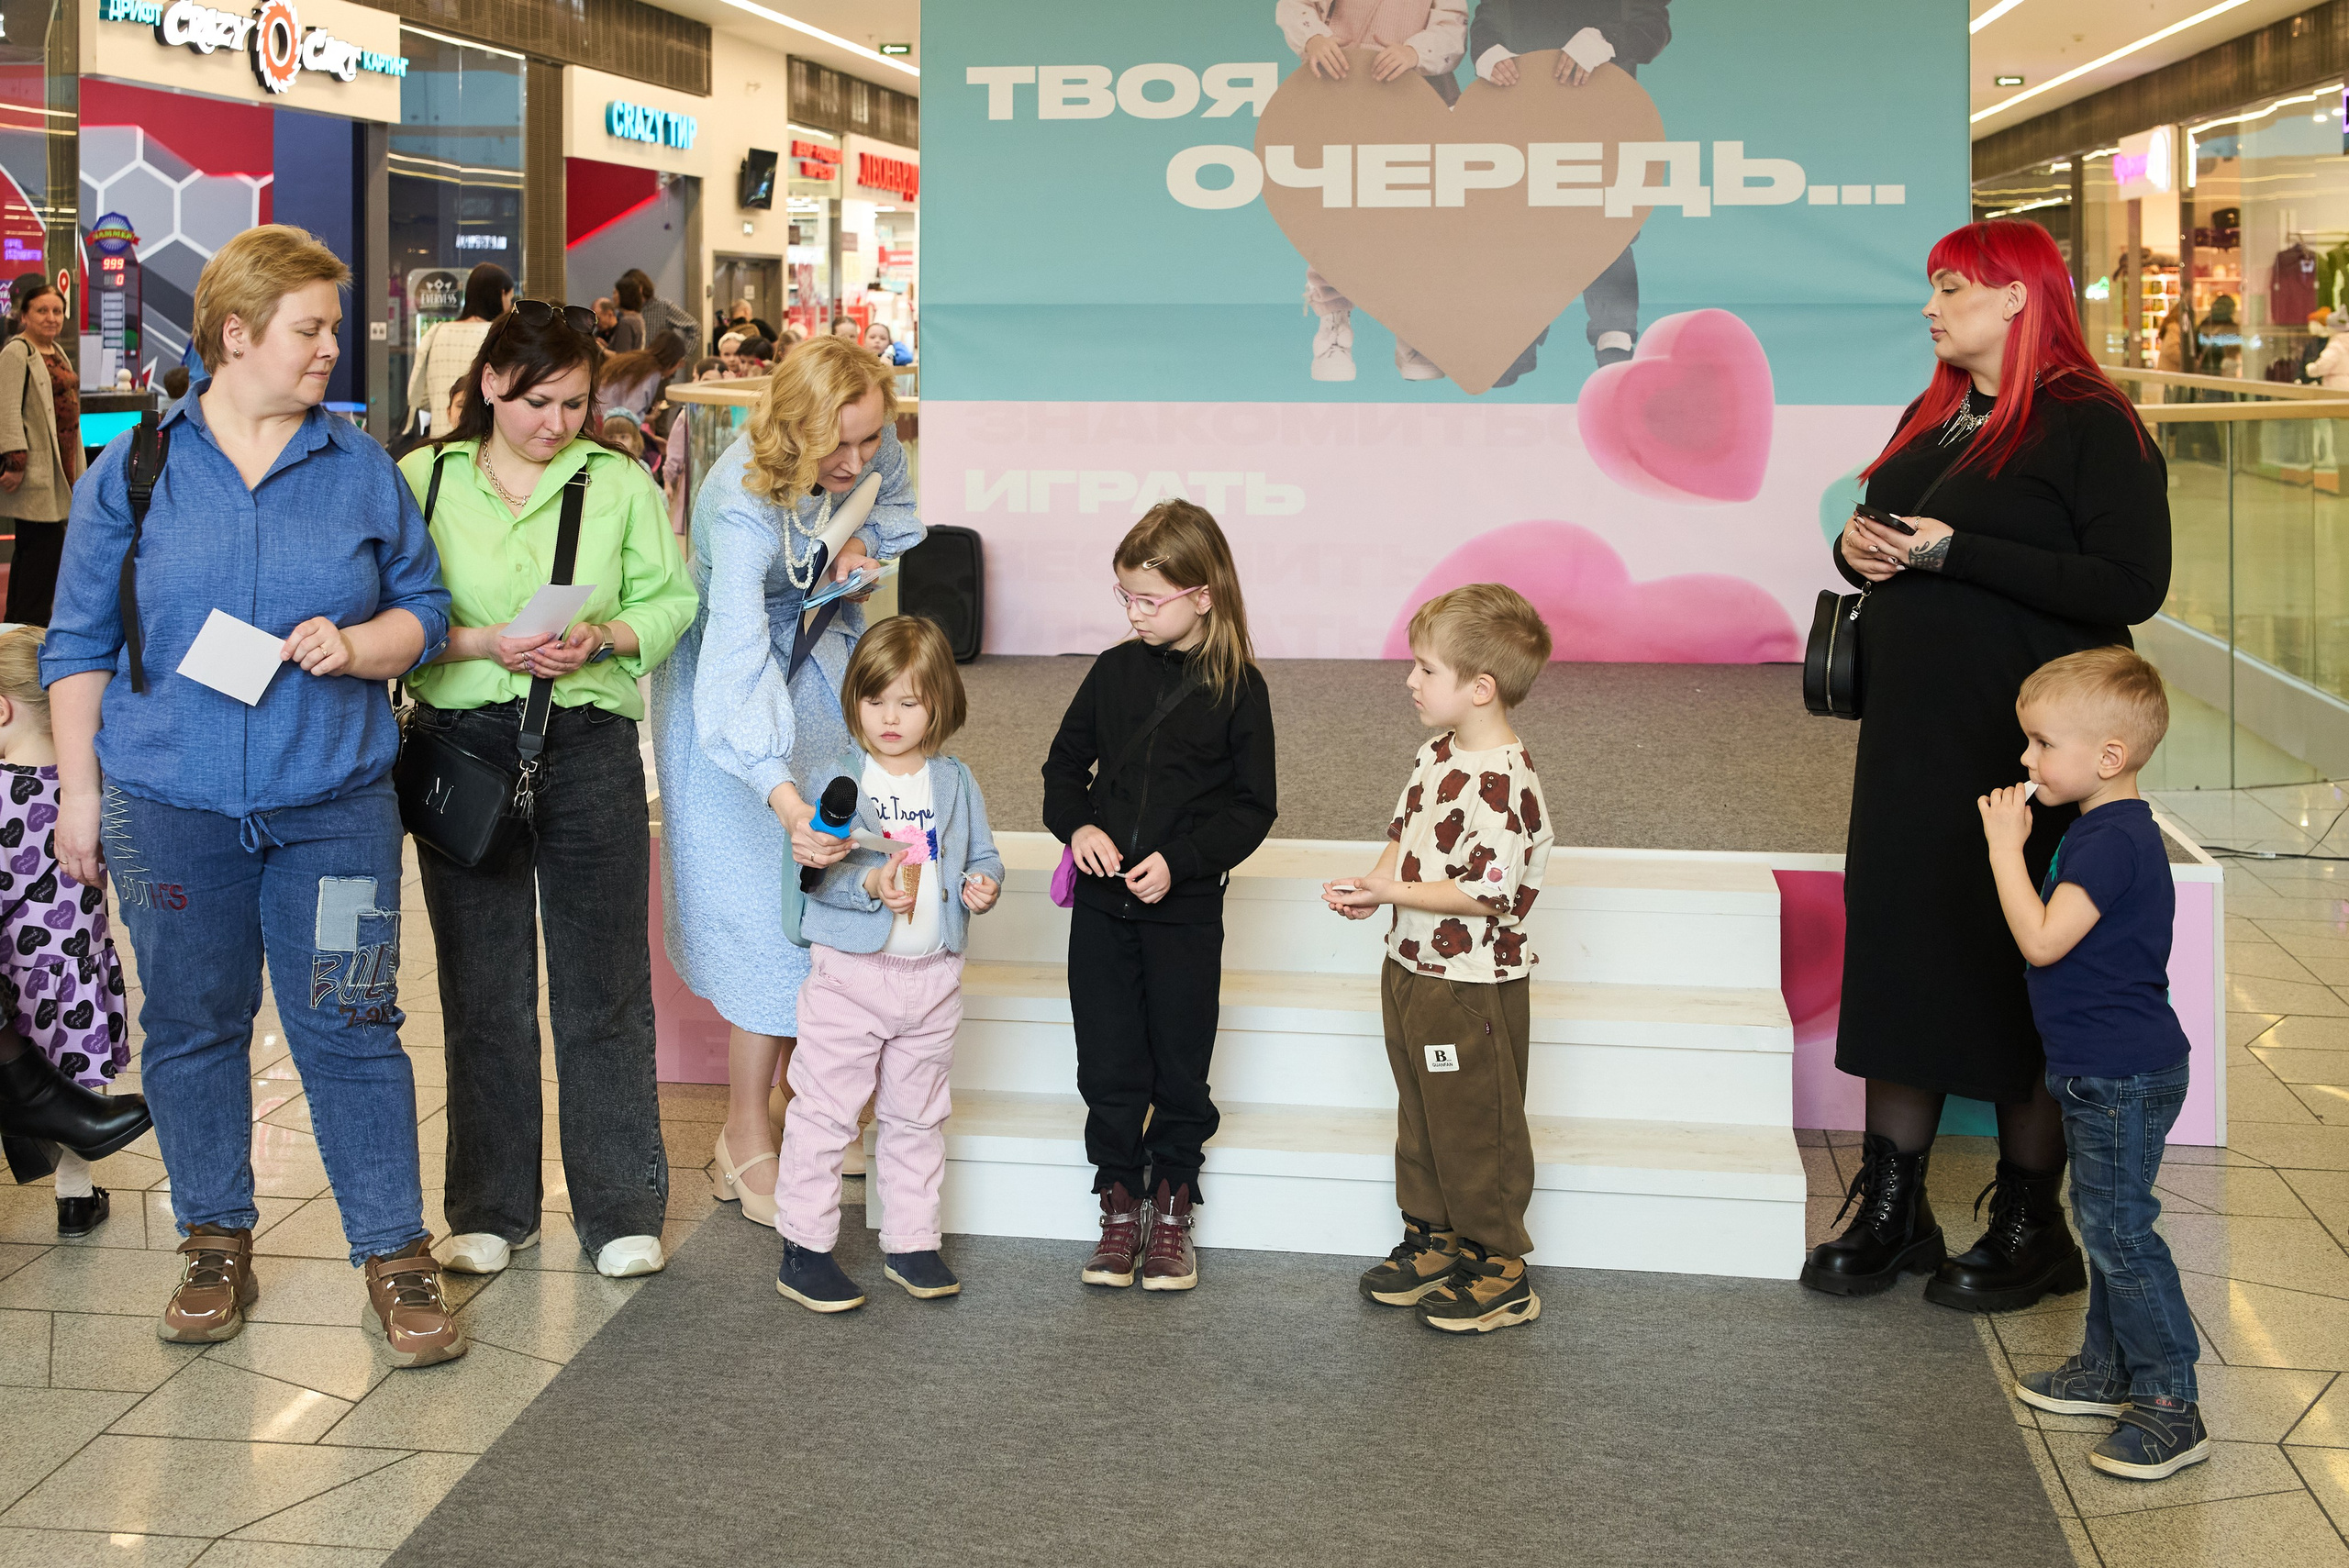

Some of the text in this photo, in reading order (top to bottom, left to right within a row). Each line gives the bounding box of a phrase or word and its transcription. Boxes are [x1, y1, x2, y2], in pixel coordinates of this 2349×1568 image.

[161, 0, 257, 55] CRAZY
[362, 50, 409, 78] КАРТИНГ
[965, 62, 1279, 121] ТВОЯ
[609, 99, 697, 150] CRAZY ТИР
[1165, 139, 1907, 218] ОЧЕРЕДЬ...
[103, 257, 124, 270] 999
[116, 273, 124, 286] 0
[964, 469, 1307, 516] ИГРАТЬ
